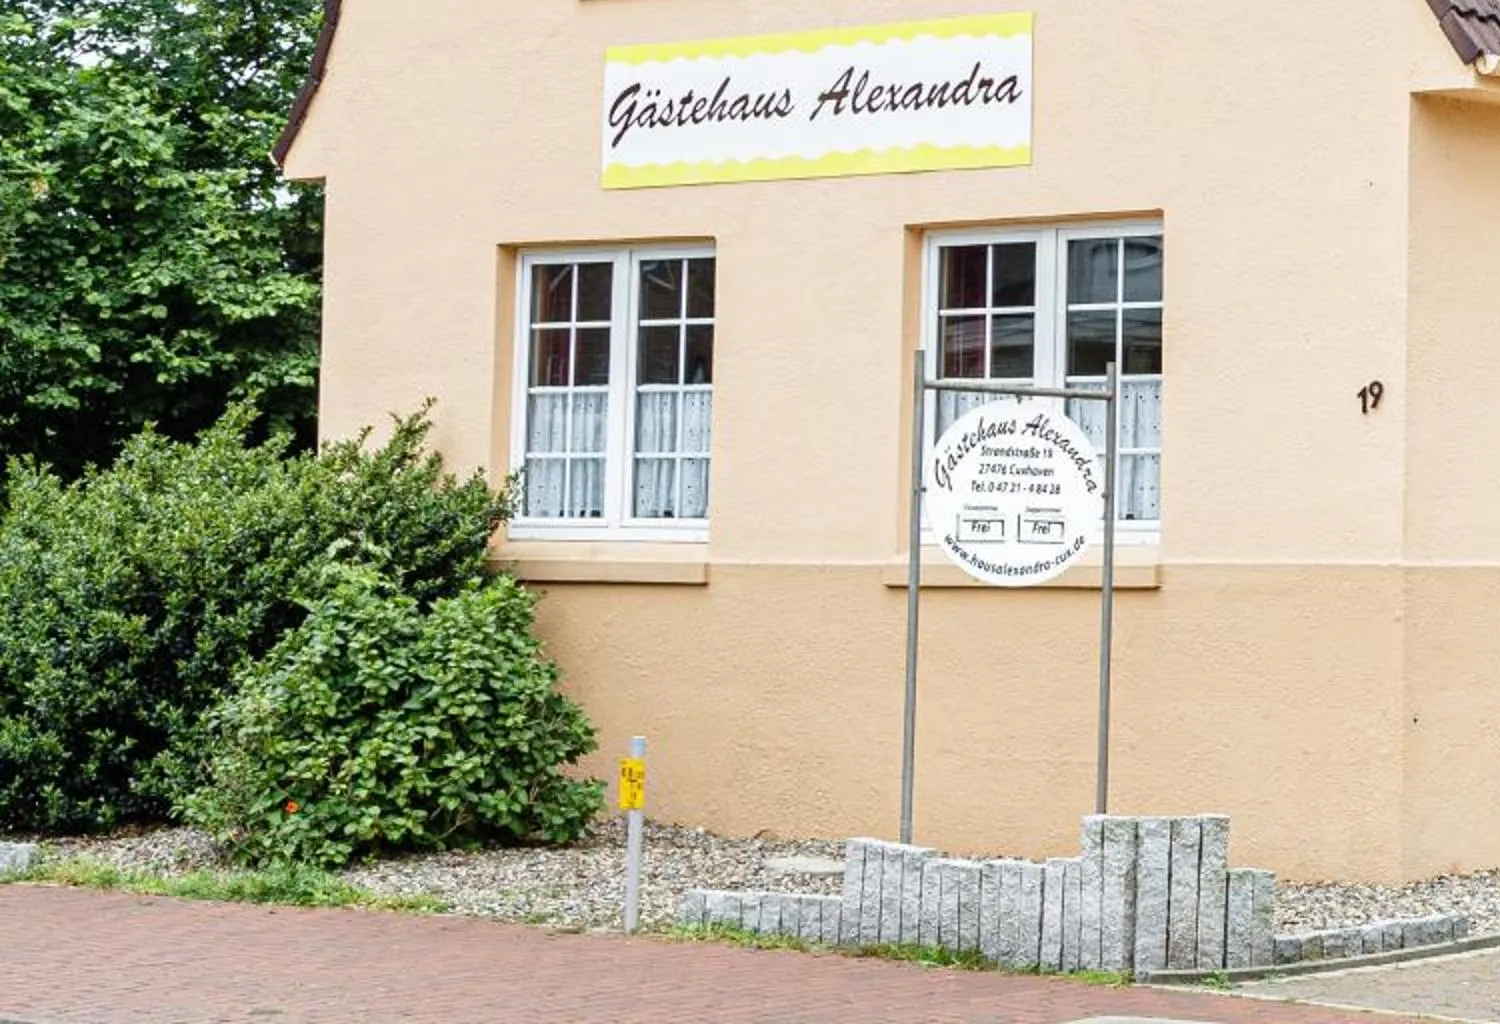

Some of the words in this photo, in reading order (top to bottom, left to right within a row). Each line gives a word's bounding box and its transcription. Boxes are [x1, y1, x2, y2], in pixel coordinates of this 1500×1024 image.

[608, 76, 795, 148] Gästehaus
[809, 62, 1022, 121] Alexandra
[1356, 380, 1383, 416] 19
[935, 416, 1017, 492] Gästehaus
[1020, 413, 1098, 494] Alexandra
[981, 445, 1040, 458] Strandstraße
[1009, 463, 1055, 477] Cuxhaven
[971, 520, 991, 533] Frei
[1032, 521, 1051, 535] Frei
[944, 534, 1085, 576] www.hausalexandra-cux.de
